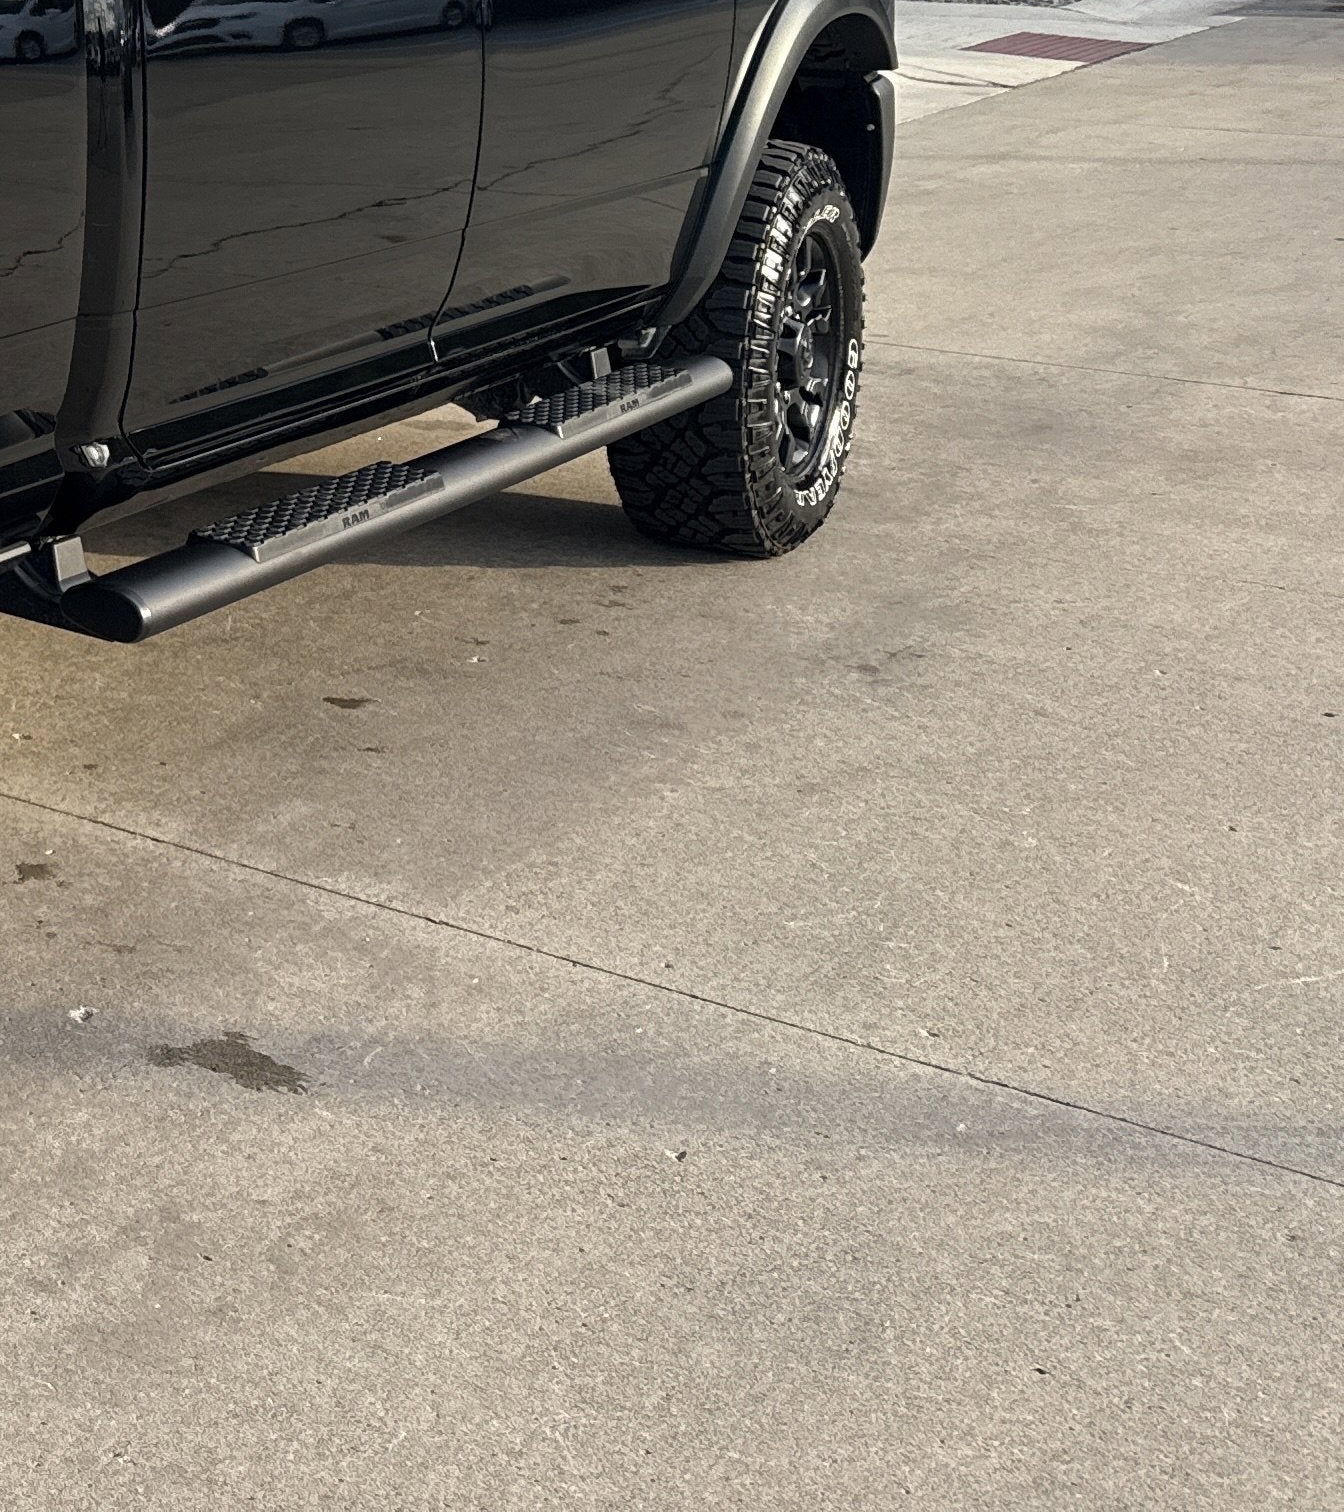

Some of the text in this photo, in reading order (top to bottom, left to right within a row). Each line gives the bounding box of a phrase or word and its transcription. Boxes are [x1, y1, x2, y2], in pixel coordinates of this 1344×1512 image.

[619, 398, 640, 413] RAM
[793, 338, 859, 507] GOODYEAR
[342, 509, 370, 529] RAM
